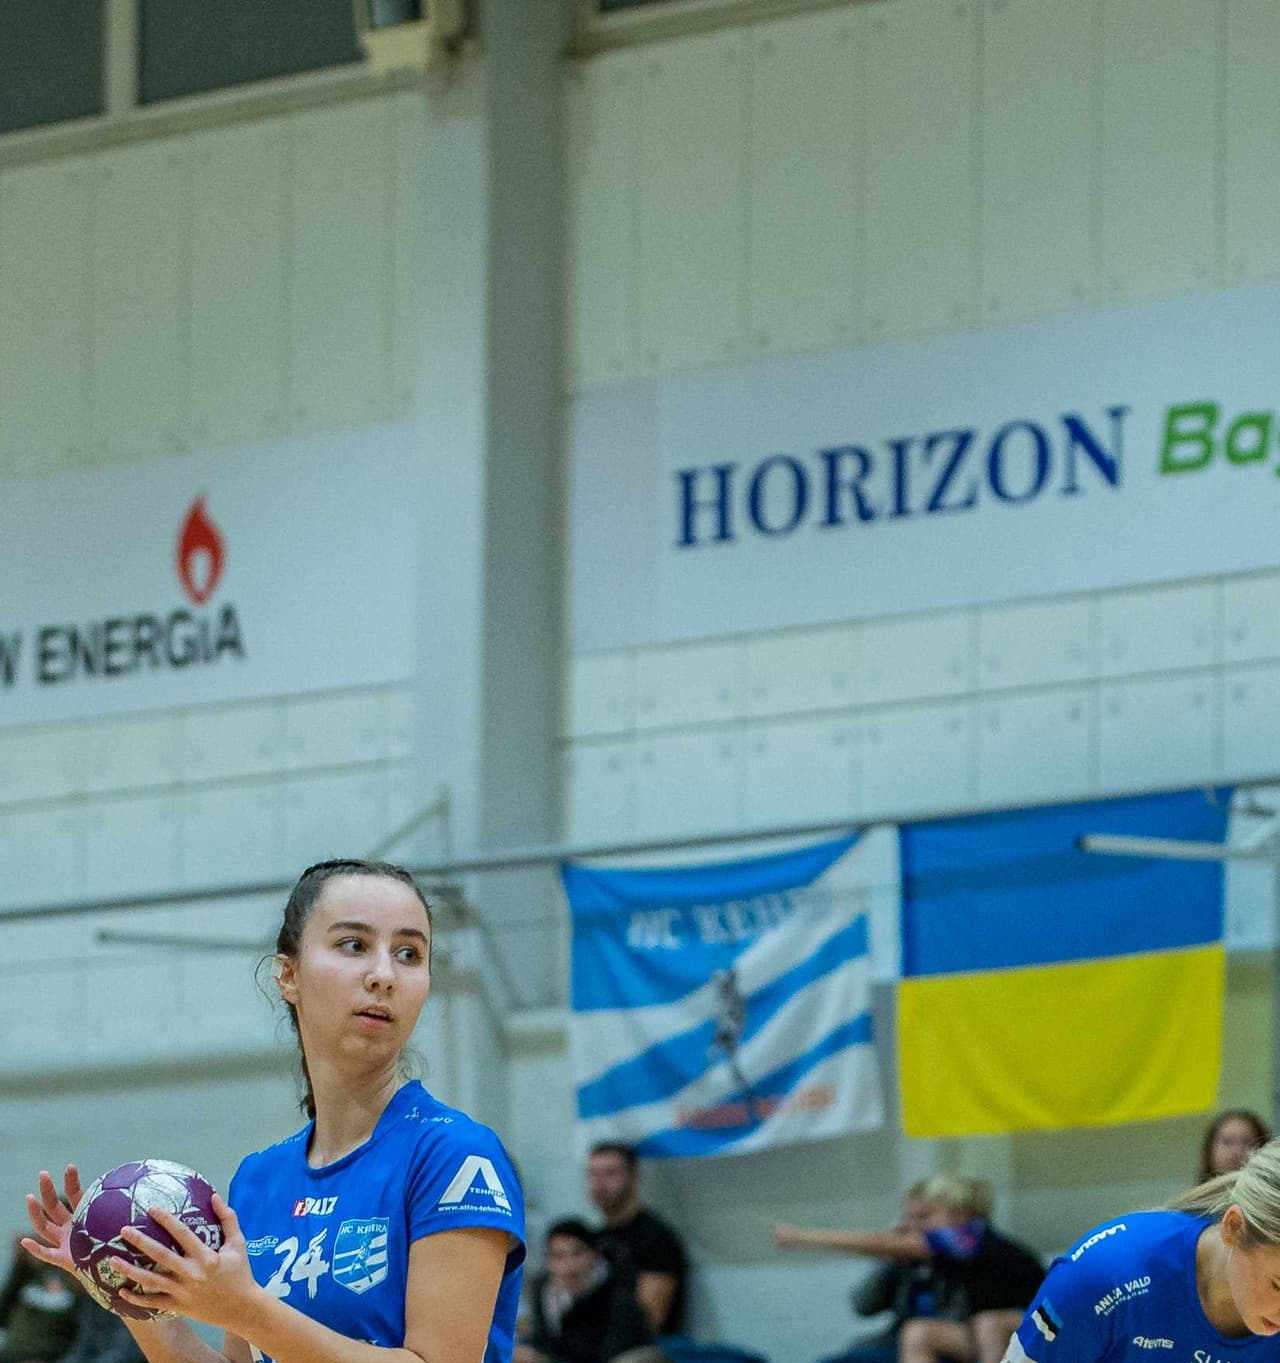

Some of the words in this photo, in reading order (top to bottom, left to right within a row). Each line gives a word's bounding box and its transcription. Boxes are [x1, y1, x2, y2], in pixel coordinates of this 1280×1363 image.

[674, 404, 1131, 551] HORIZON
[263, 1227, 330, 1299] 24
[1124, 1275, 1151, 1293] VALD
